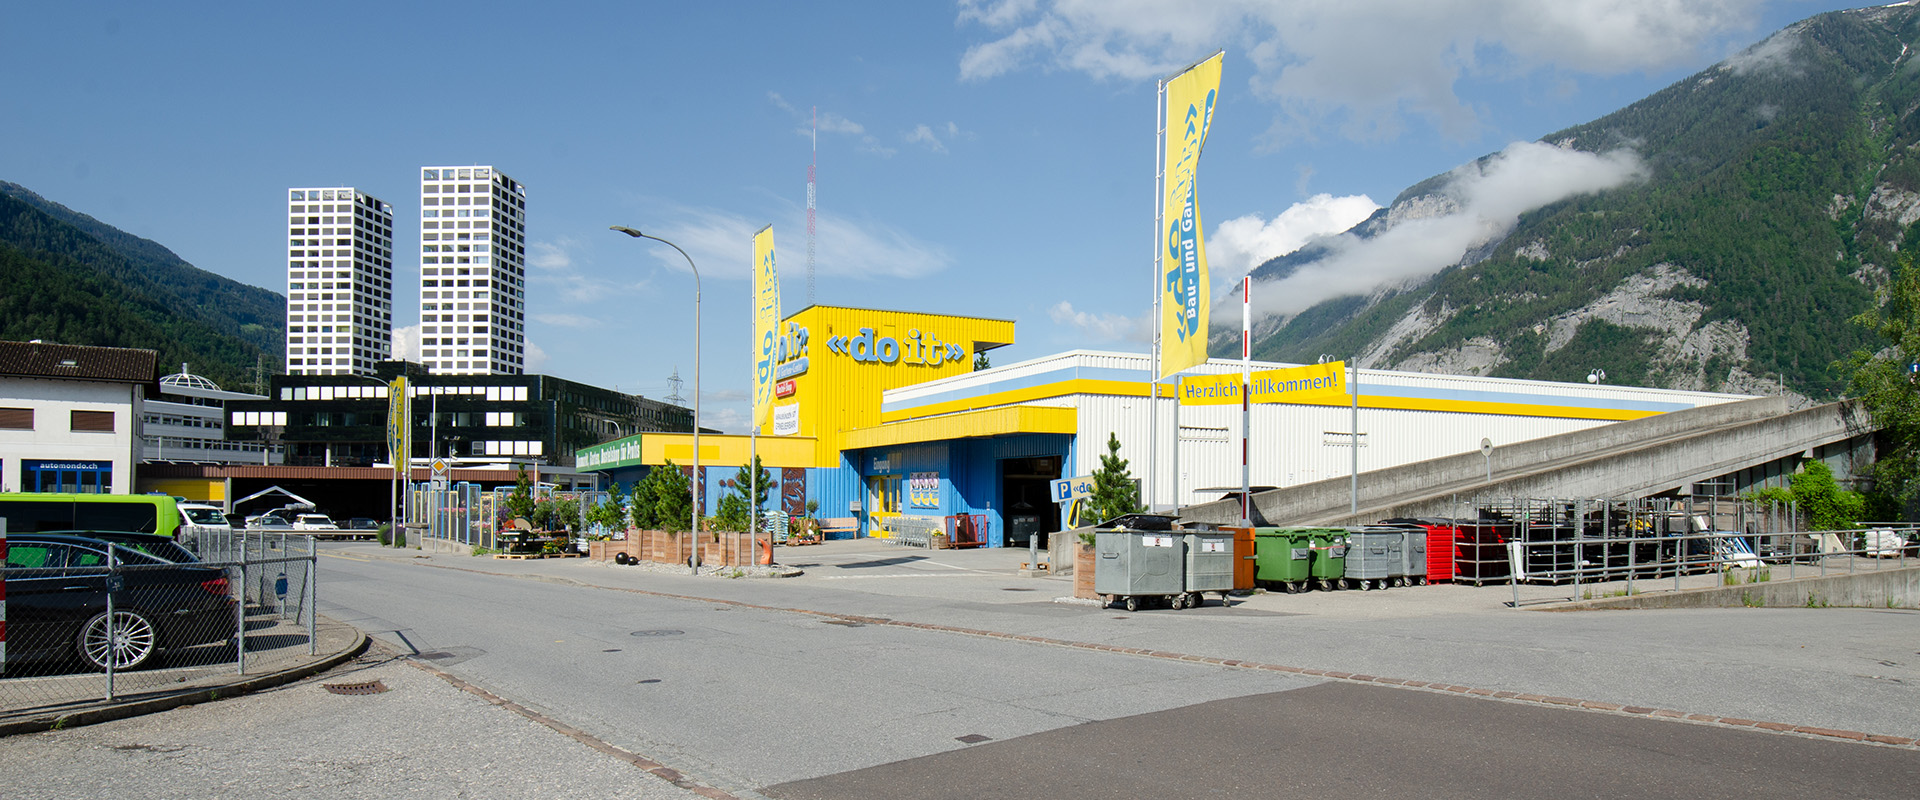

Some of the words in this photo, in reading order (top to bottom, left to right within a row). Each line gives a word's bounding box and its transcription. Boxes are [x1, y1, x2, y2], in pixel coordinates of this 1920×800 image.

[1182, 238, 1195, 273] und
[1186, 278, 1197, 319] Bau-
[1185, 381, 1237, 399] Herzlich
[873, 457, 890, 474] Eingang
[1060, 483, 1069, 498] P
